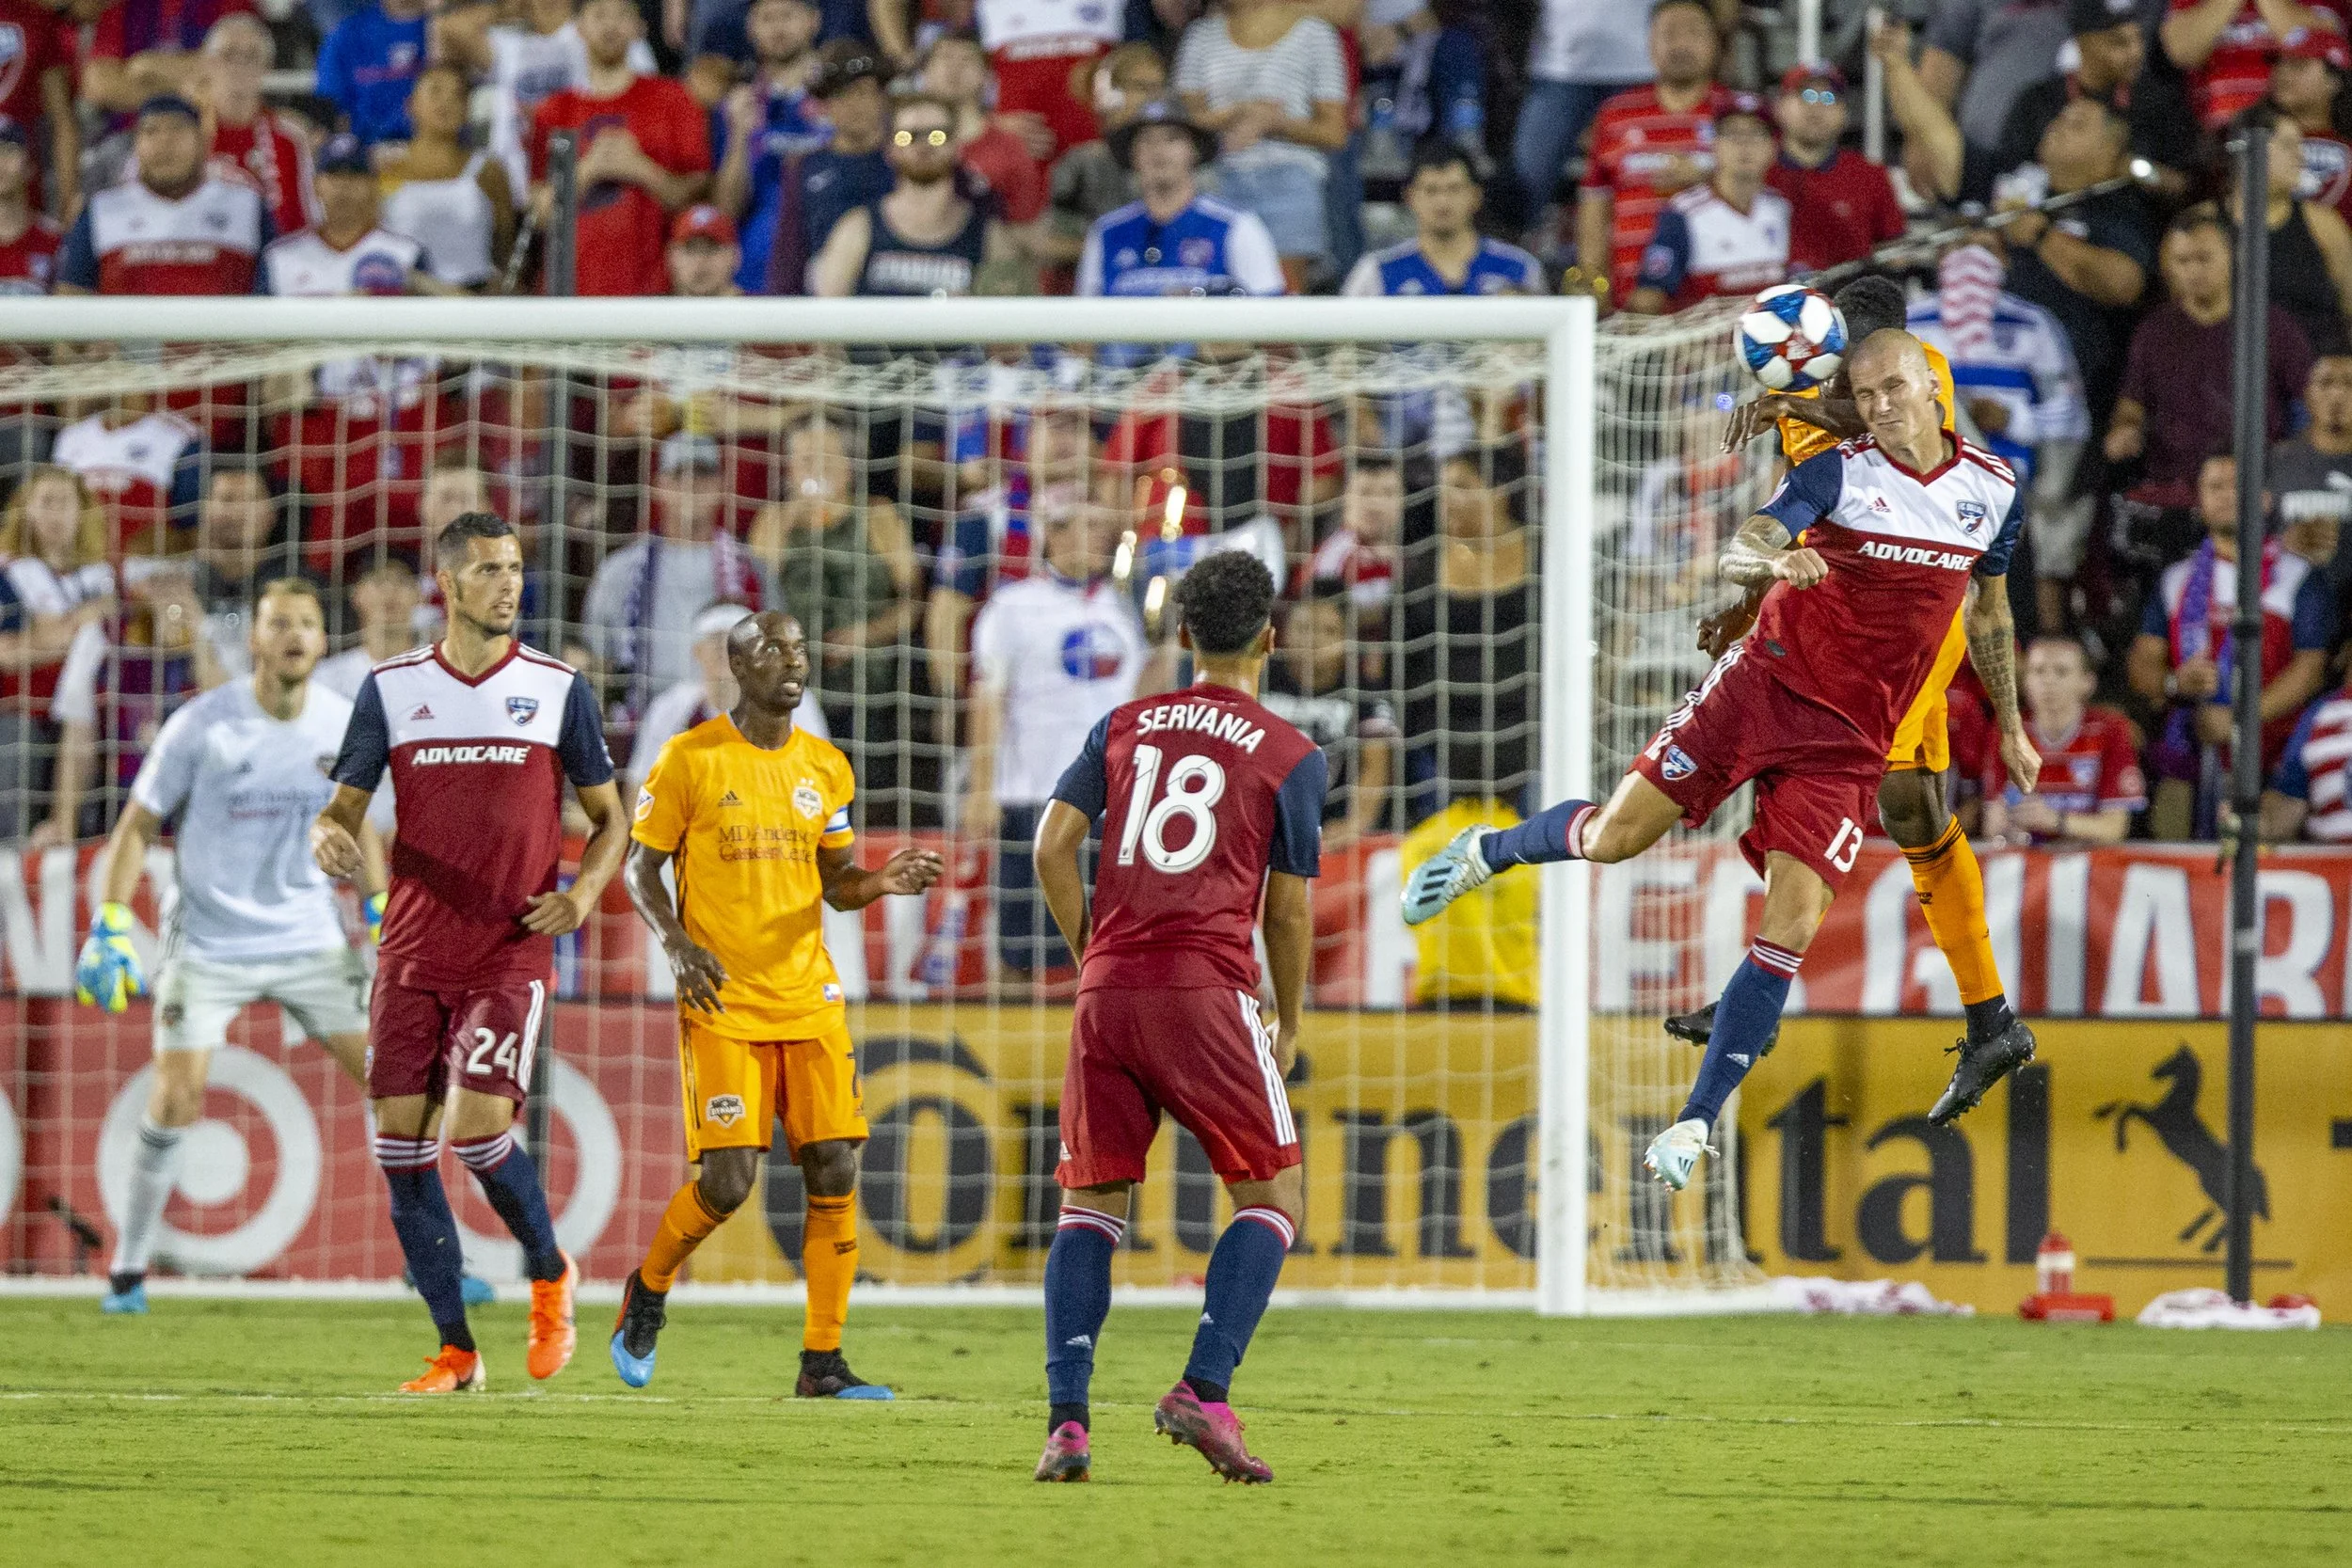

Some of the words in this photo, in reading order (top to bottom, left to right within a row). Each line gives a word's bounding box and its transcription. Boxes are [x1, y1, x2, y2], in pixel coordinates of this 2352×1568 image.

[1857, 541, 1975, 571] ADVOCARE
[1136, 704, 1266, 754] SERVANIA
[411, 746, 530, 768] ADVOCARE
[718, 824, 750, 843] MD
[1116, 743, 1227, 874] 18
[1823, 816, 1864, 873] 13
[466, 1026, 519, 1080] 24
[762, 1030, 2051, 1284] Connental
